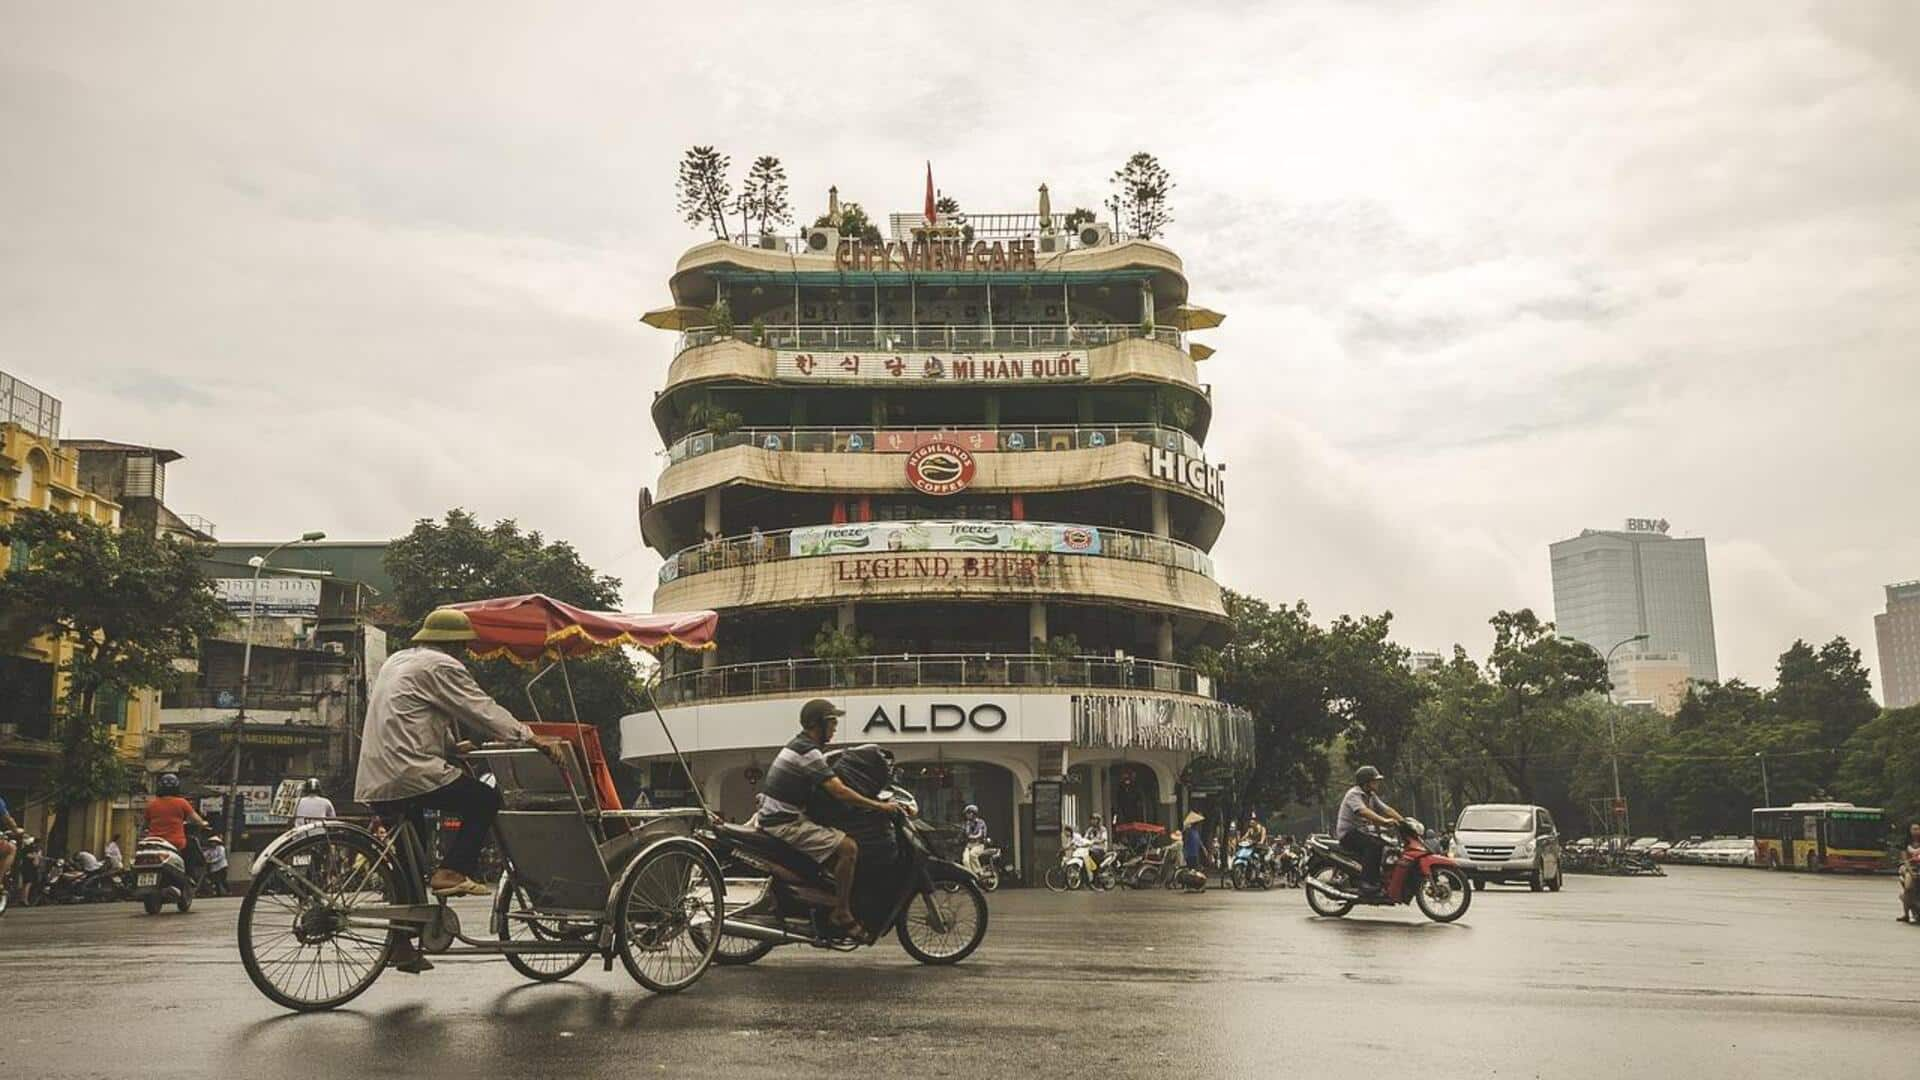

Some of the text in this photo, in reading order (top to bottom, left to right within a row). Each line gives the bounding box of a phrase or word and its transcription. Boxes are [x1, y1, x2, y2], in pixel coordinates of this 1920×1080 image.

[836, 239, 1036, 271] CITY VIEW CAFE
[983, 354, 1024, 379] HÀN
[908, 443, 972, 467] HIGHLANDS
[917, 479, 964, 492] COFFEE
[824, 527, 864, 539] freeze
[950, 524, 992, 536] freeze
[1627, 518, 1657, 531] BIDV
[838, 556, 950, 580] LEGEND
[862, 703, 1007, 733] ALDO
